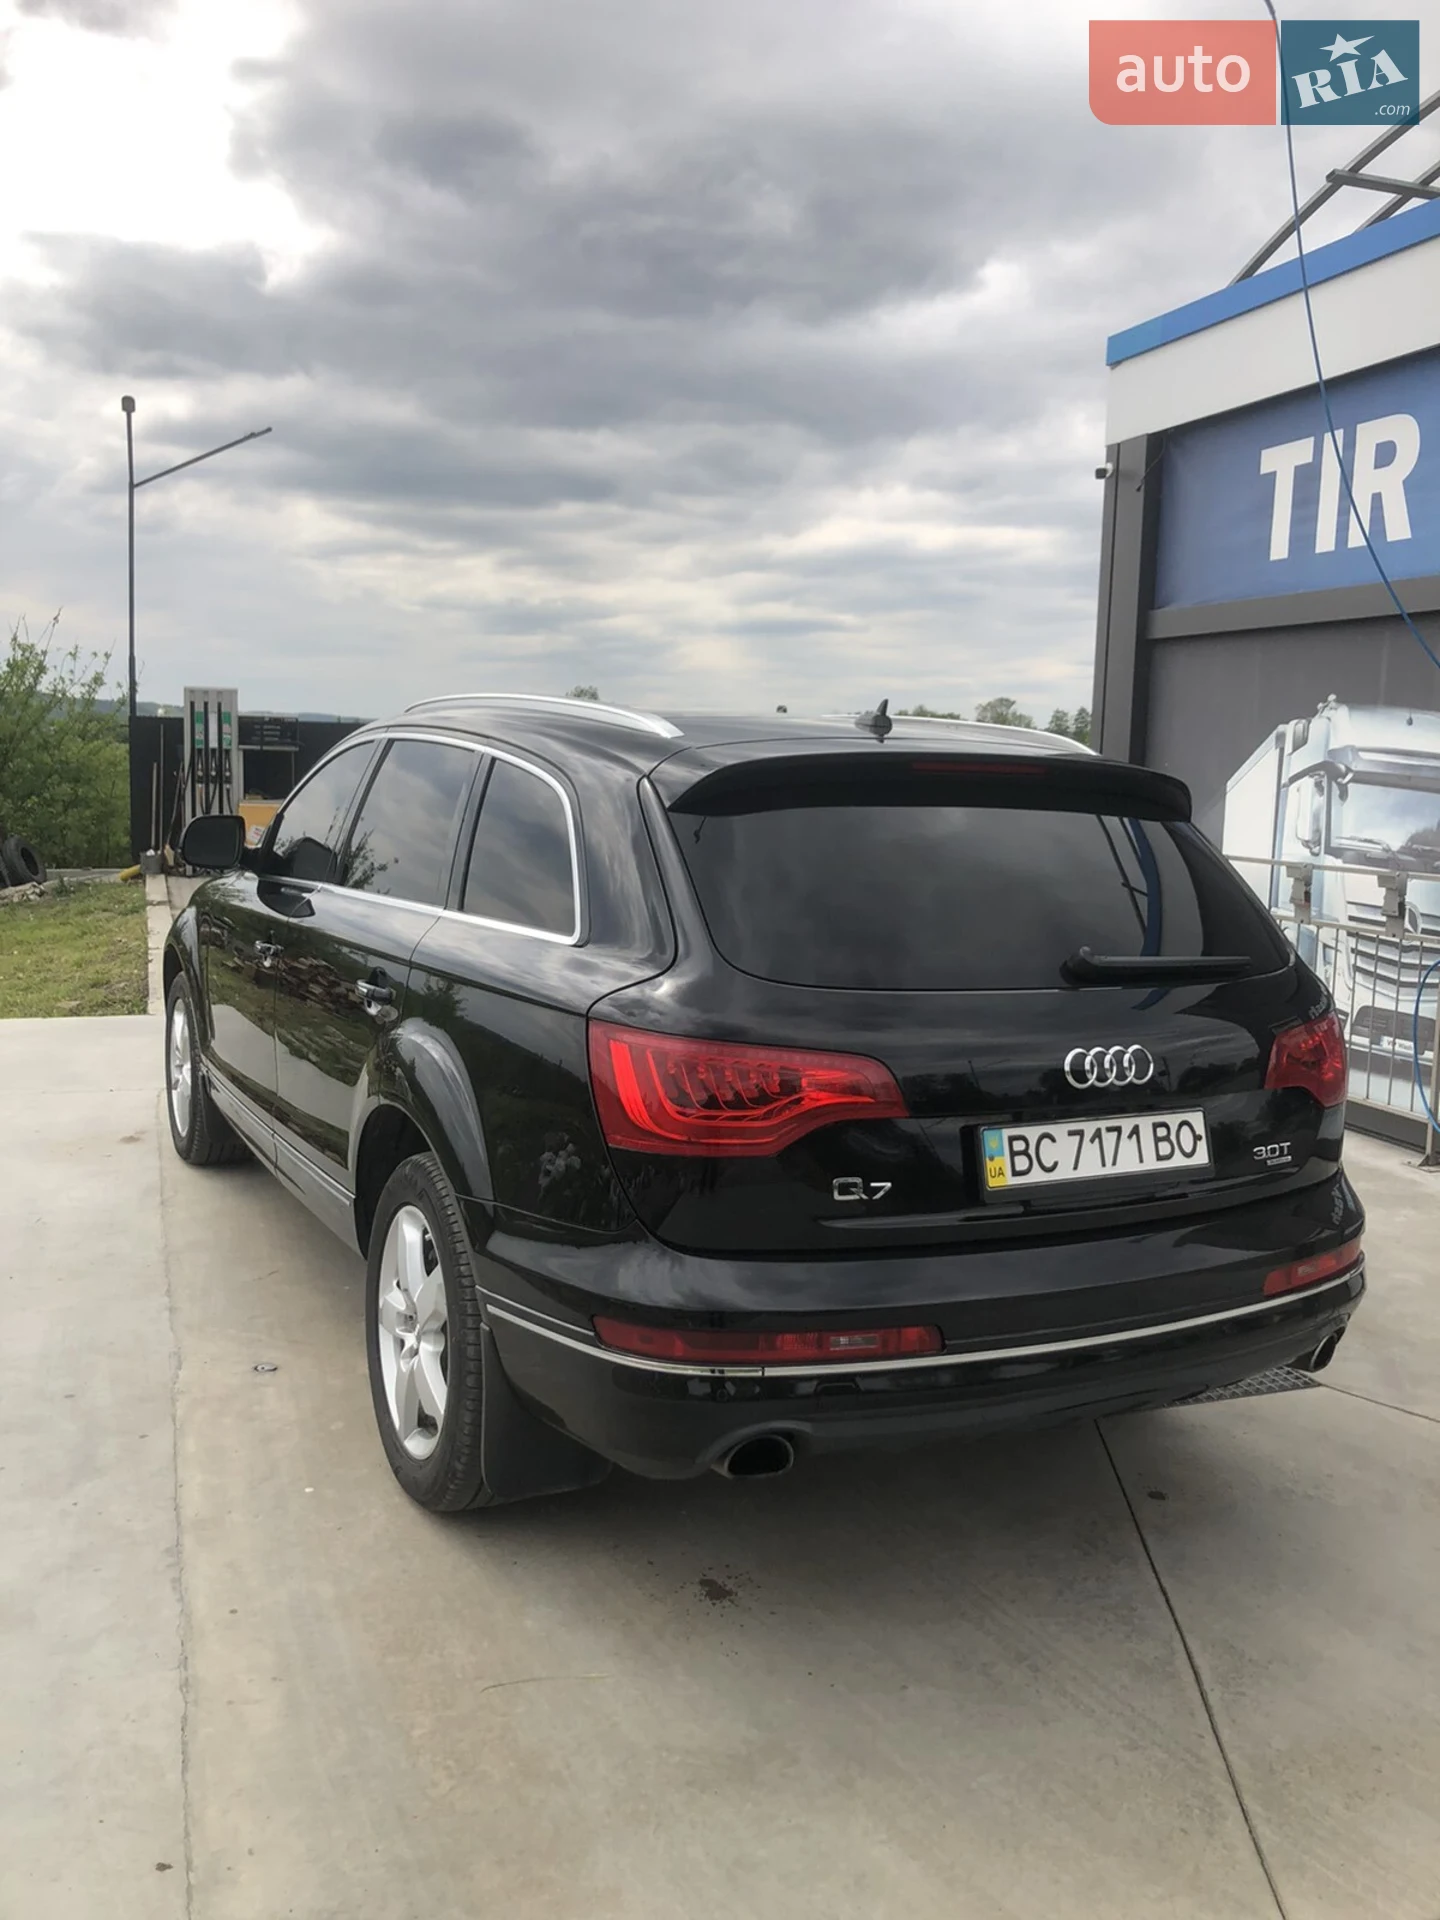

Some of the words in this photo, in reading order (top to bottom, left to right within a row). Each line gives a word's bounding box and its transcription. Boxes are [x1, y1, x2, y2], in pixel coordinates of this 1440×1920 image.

[1260, 413, 1421, 561] TIR
[1008, 1131, 1059, 1178] BC
[1067, 1124, 1144, 1171] 7171
[1151, 1119, 1199, 1163] BO
[832, 1176, 892, 1201] Q7
[989, 1166, 1005, 1179] UA
